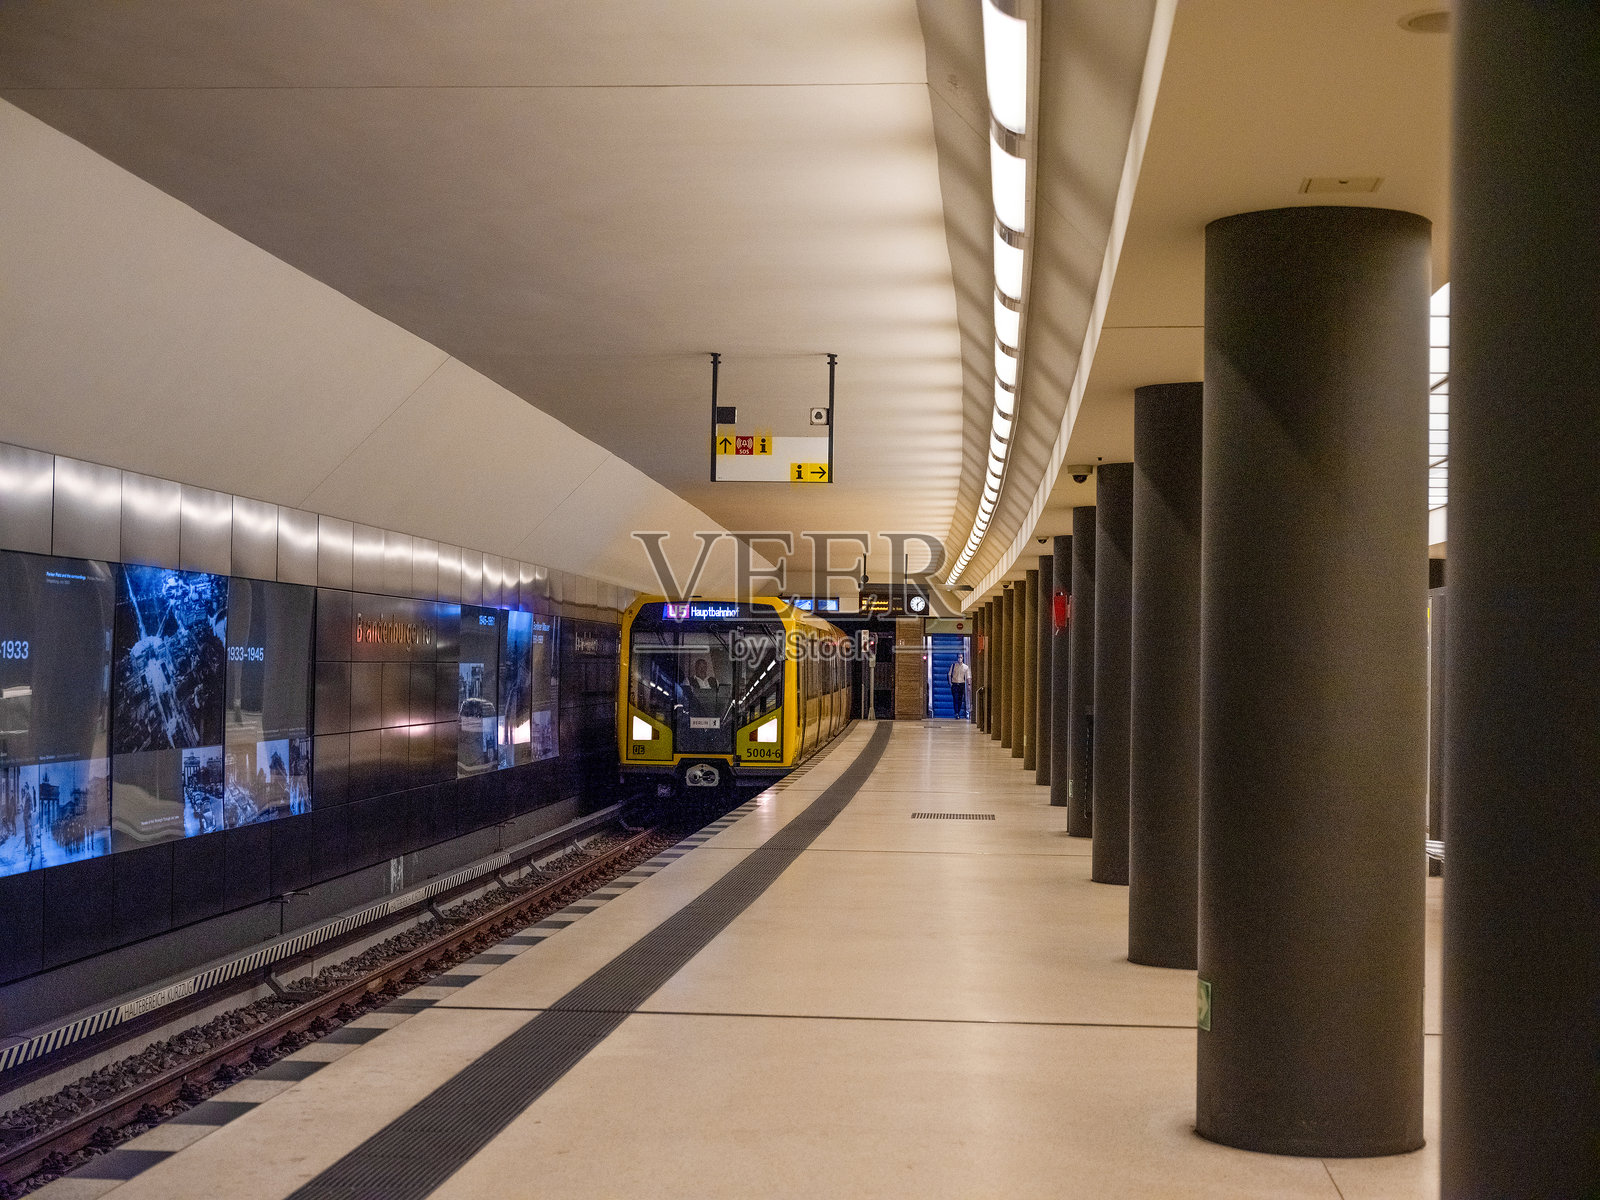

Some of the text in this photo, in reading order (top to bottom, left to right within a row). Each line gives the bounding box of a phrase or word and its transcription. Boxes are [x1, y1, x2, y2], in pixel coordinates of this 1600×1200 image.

[668, 604, 740, 620] U5 Hauptbahnhof
[356, 612, 419, 652] Brandenburger
[227, 646, 264, 661] 1933-1945
[746, 748, 781, 759] 5004-6
[123, 980, 193, 1019] HALTEBEREICH KURZZUG
